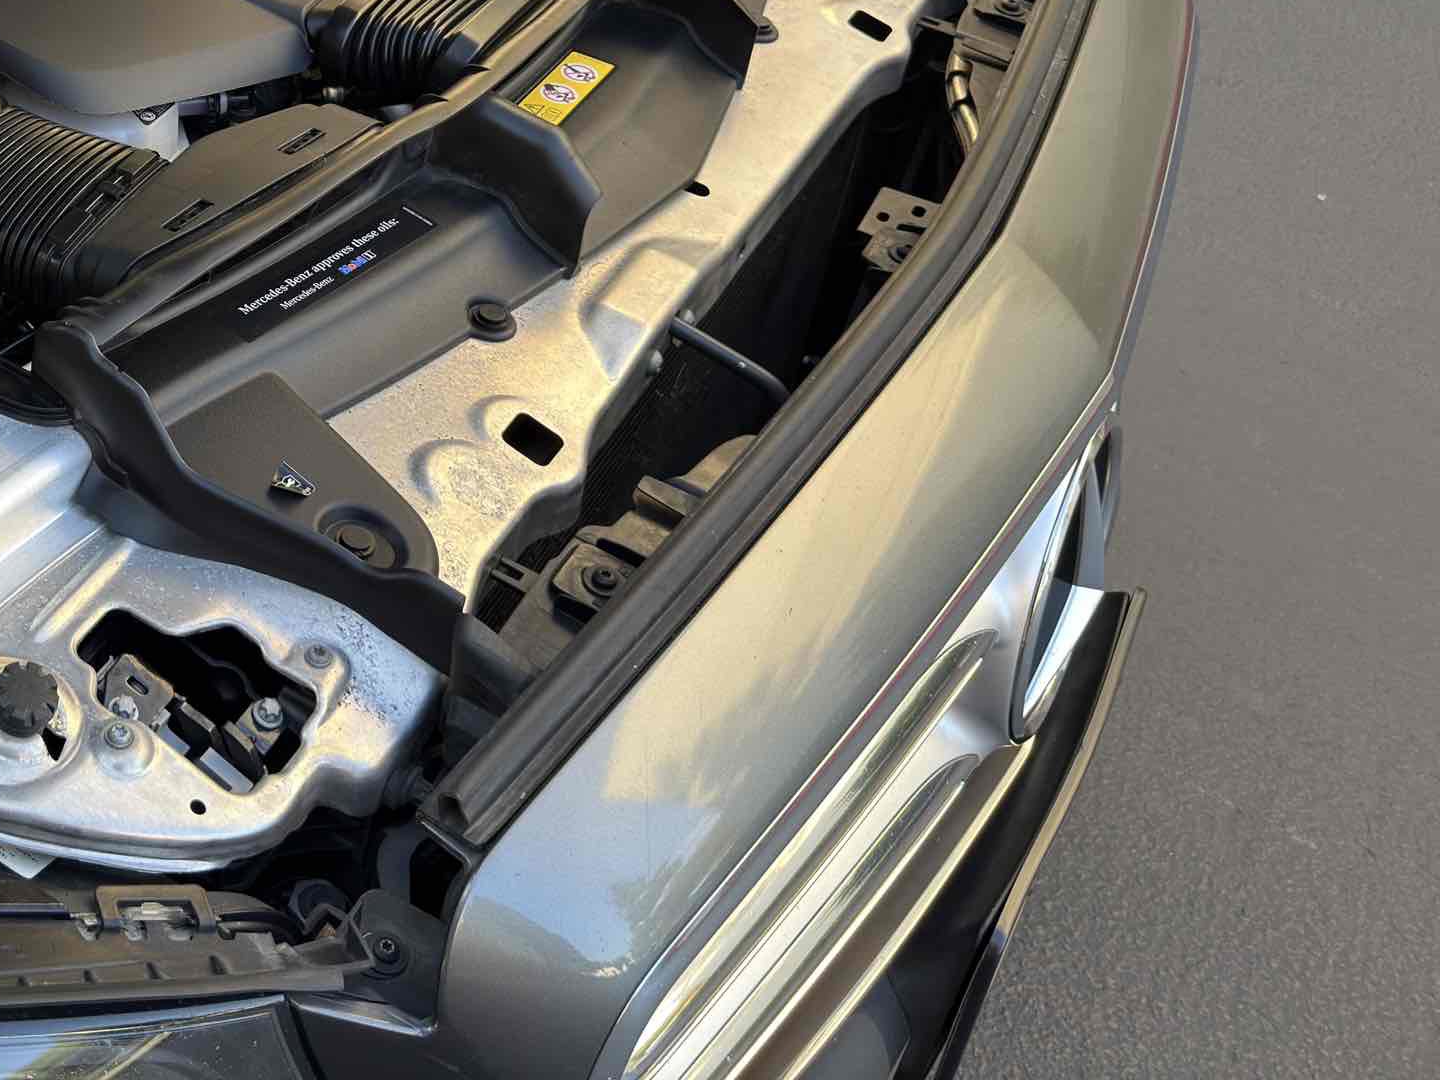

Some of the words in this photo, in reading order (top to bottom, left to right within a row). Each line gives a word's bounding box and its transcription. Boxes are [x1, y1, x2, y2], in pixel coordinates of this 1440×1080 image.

[237, 269, 314, 315] Mercedes-Benz
[311, 244, 354, 274] approves
[352, 230, 379, 248] these
[377, 217, 399, 233] oils:
[279, 275, 335, 310] Mercedes-Benz
